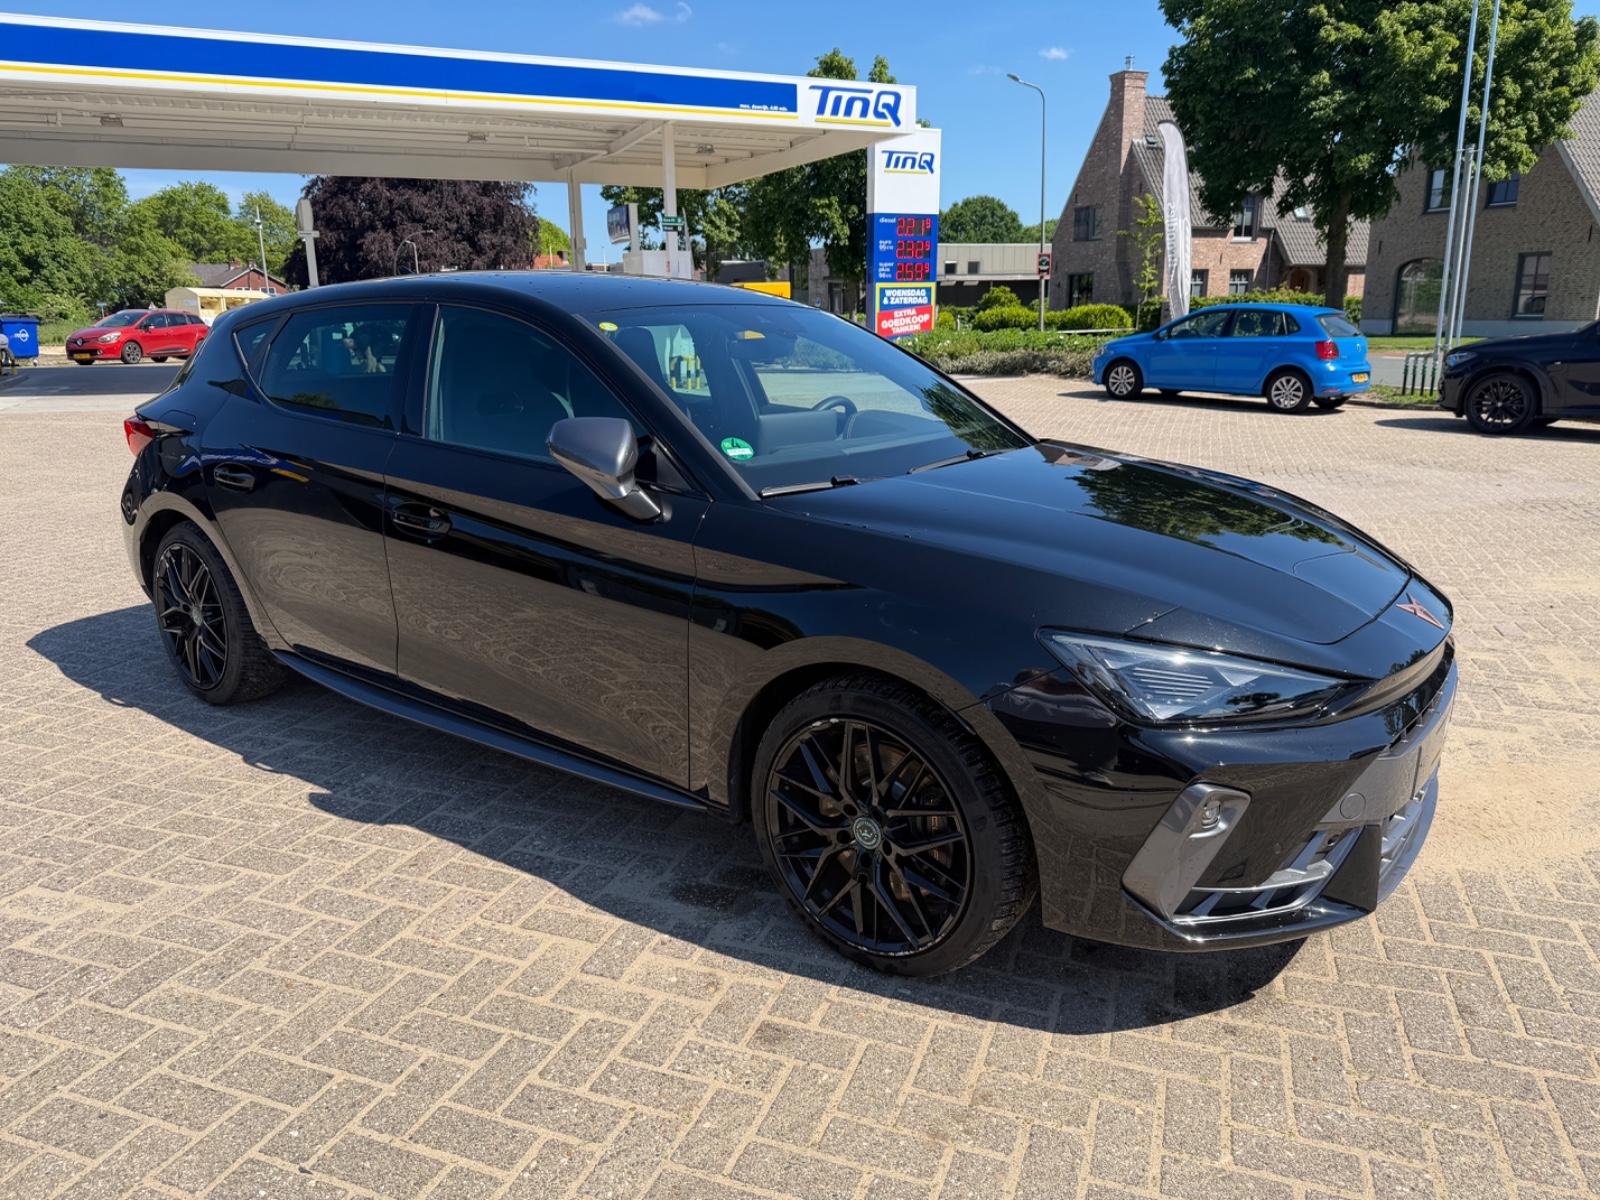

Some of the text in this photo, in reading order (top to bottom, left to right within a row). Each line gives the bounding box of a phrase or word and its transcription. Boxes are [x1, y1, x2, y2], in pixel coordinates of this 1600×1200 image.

[885, 289, 926, 297] WOENSDAG
[894, 308, 917, 318] EXTRA
[881, 314, 930, 328] GOEDKOOP
